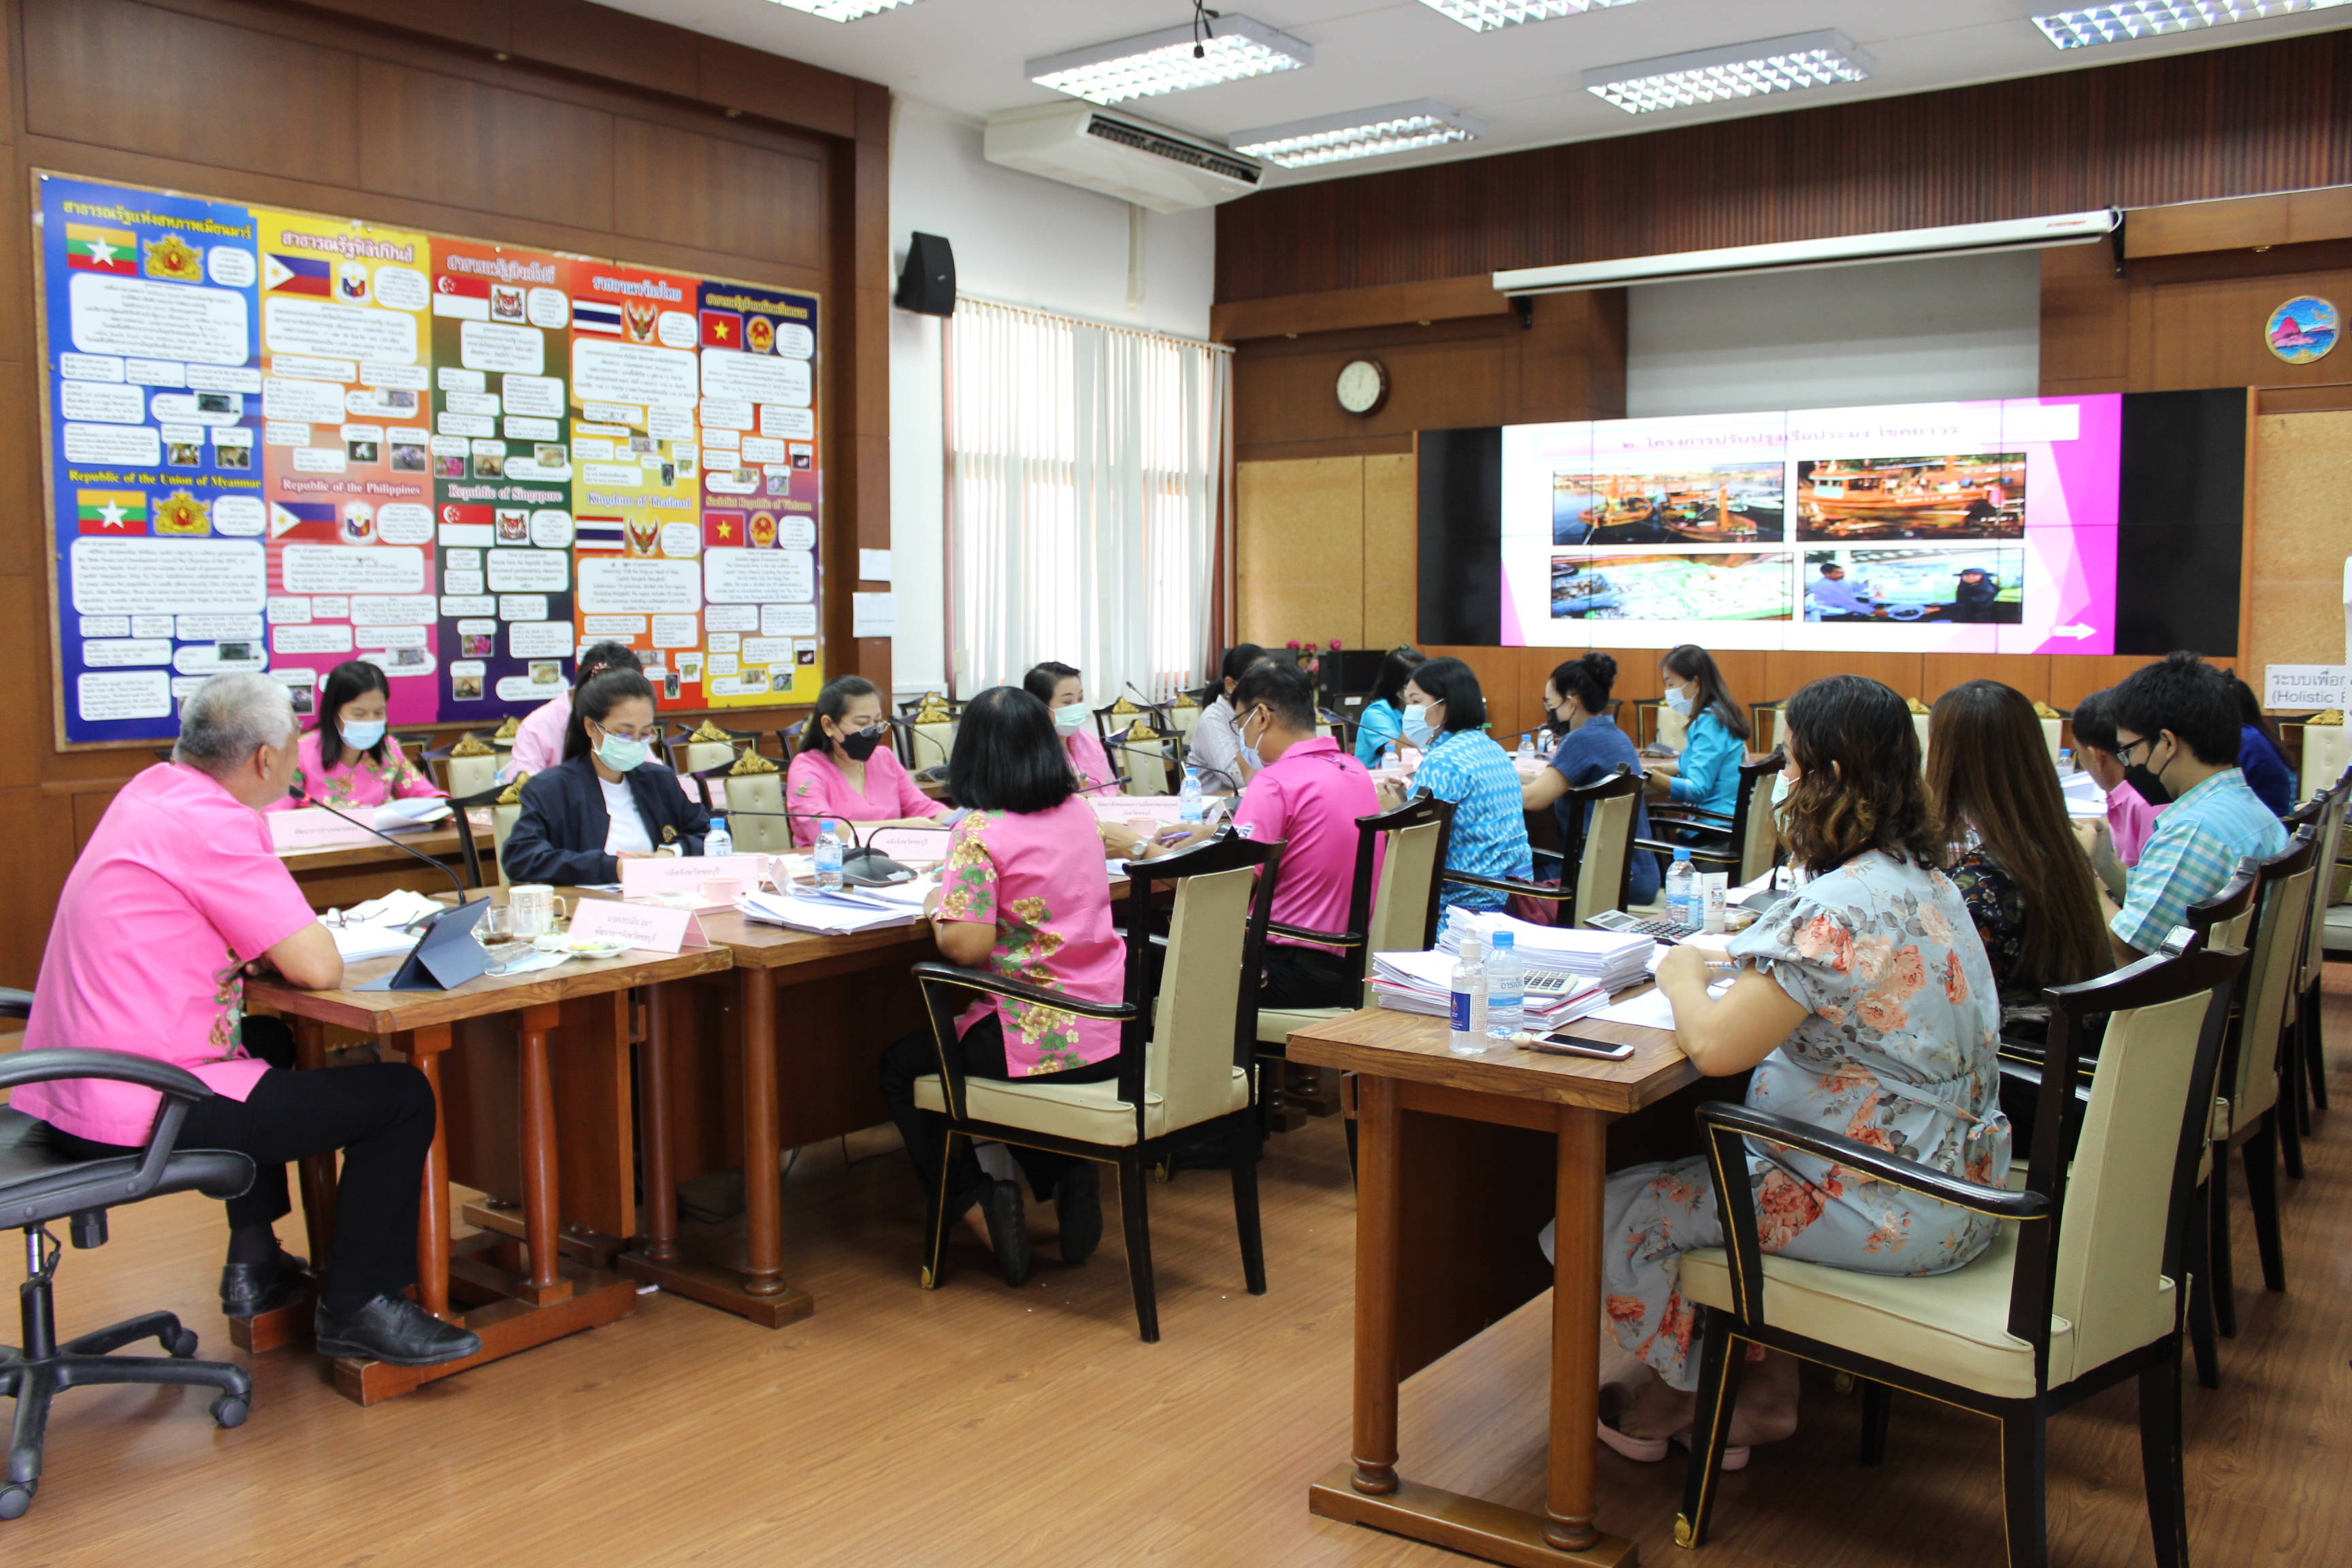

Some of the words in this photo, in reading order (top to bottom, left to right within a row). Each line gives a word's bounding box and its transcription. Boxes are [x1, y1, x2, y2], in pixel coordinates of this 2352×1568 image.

[281, 231, 414, 263] สาธารณรัฐฟิลิปปินส์
[592, 276, 683, 302] ราชอาณาจักรไทย
[68, 470, 120, 484] Republic
[123, 472, 136, 483] of
[138, 472, 157, 484] the
[160, 474, 194, 485] Union
[196, 476, 208, 486] of
[210, 476, 262, 489] Myanmar
[282, 478, 329, 493] Republic
[332, 482, 344, 492] of
[346, 482, 363, 493] the
[366, 483, 421, 496] Philippines
[448, 483, 497, 501] Republic
[497, 487, 510, 500] of
[512, 486, 564, 504] Singapore
[587, 492, 633, 508] Kingdom
[636, 495, 647, 507] of
[649, 495, 692, 509] Thailand
[706, 495, 737, 508] Socialist
[738, 497, 771, 510] Republic
[772, 499, 781, 509] of
[783, 500, 812, 511] Vietnam
[2272, 690, 2334, 704] (Holistic
